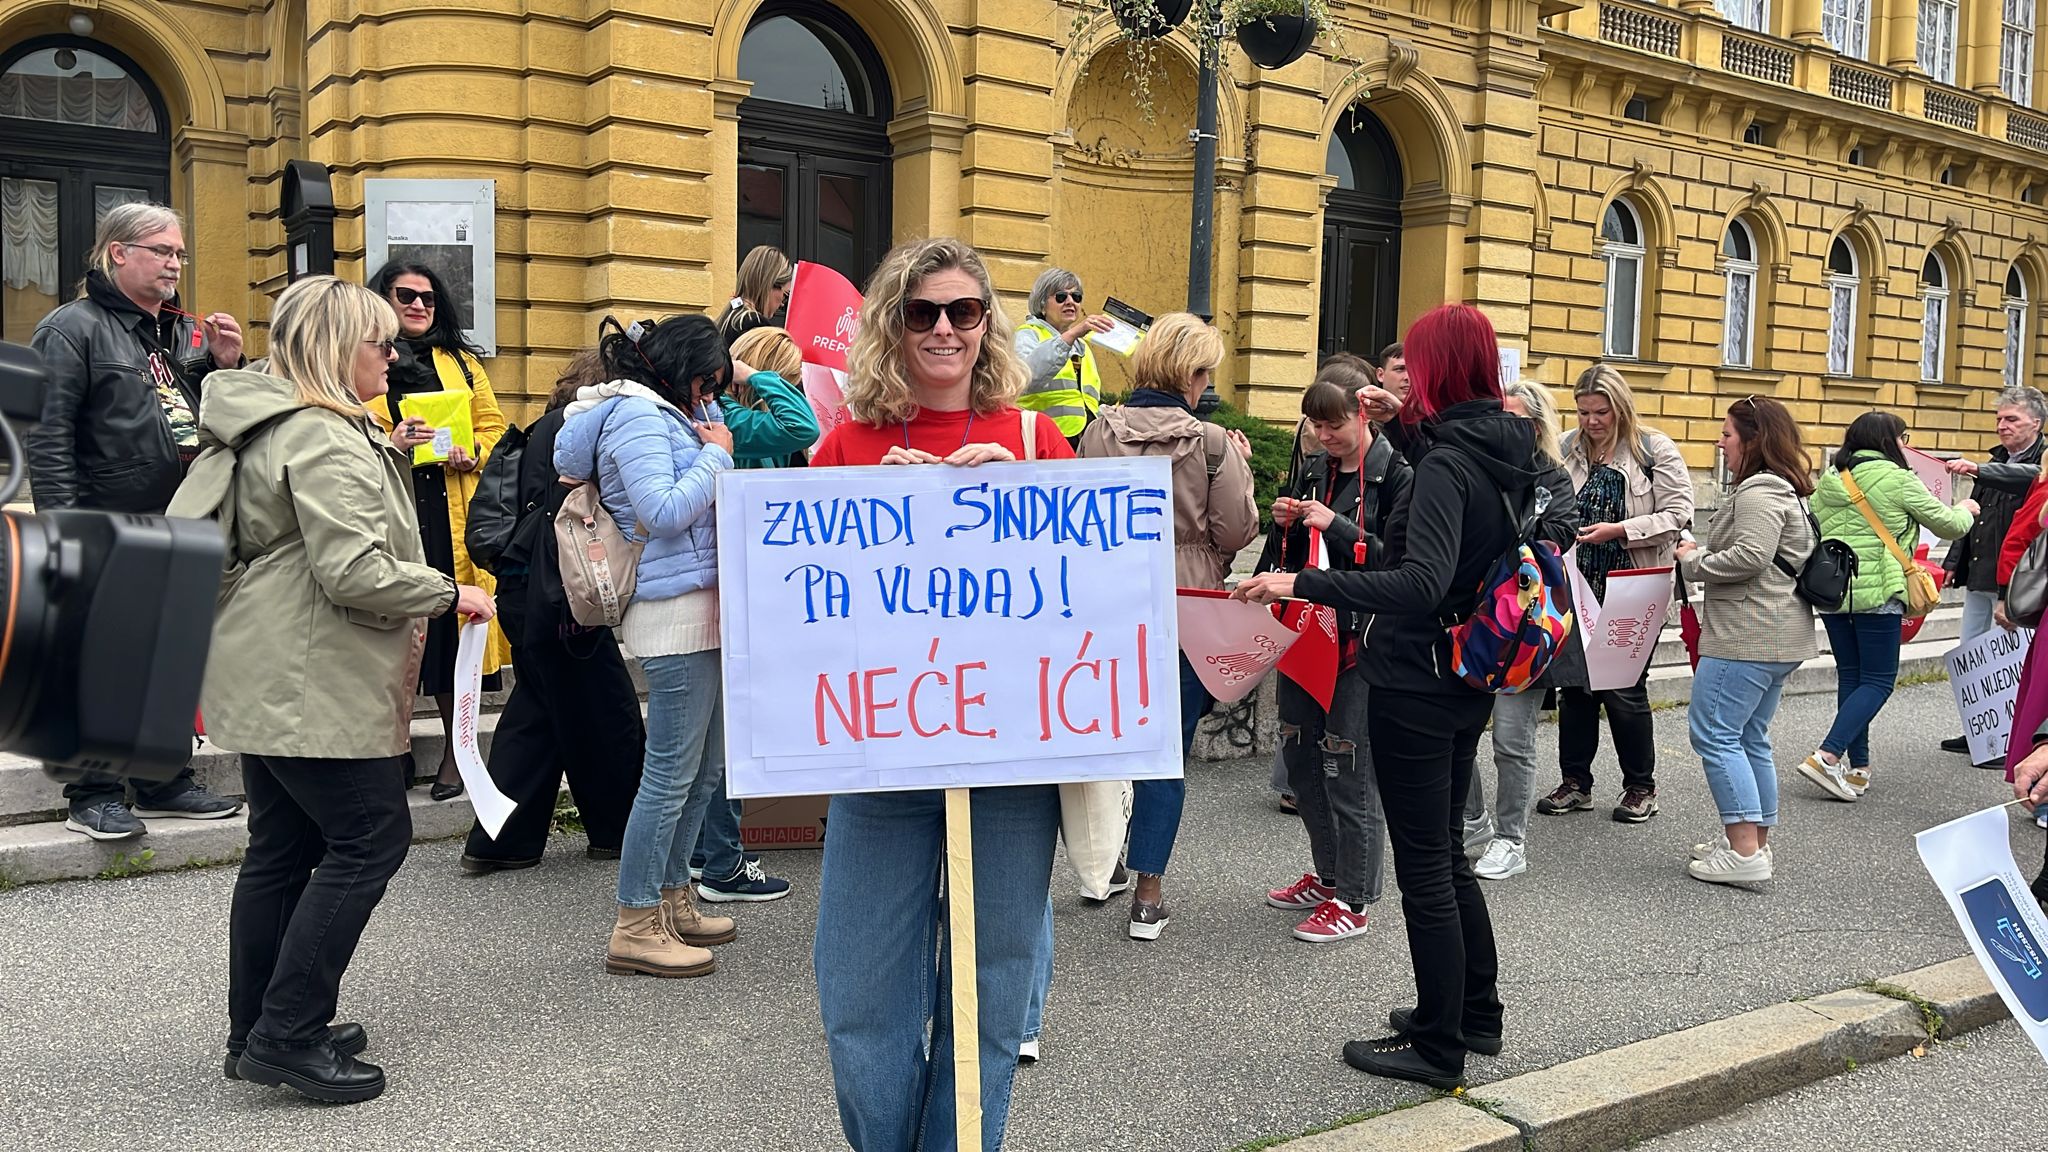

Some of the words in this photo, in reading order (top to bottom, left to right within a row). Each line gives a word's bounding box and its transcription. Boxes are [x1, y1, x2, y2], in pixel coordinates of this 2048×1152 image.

[762, 494, 915, 550] ZAVADI
[945, 482, 1167, 552] SINDIKATE
[784, 564, 851, 624] PA
[873, 555, 1073, 620] VLADAJ!
[1630, 603, 1656, 658] PREPOROD
[1952, 645, 1987, 676] IMAM
[1990, 631, 2020, 659] PUNO
[815, 637, 997, 746] NEĆE
[1038, 623, 1149, 741] IĆI!
[1961, 683, 1978, 709] ALI
[1968, 708, 1999, 738] ISPOD
